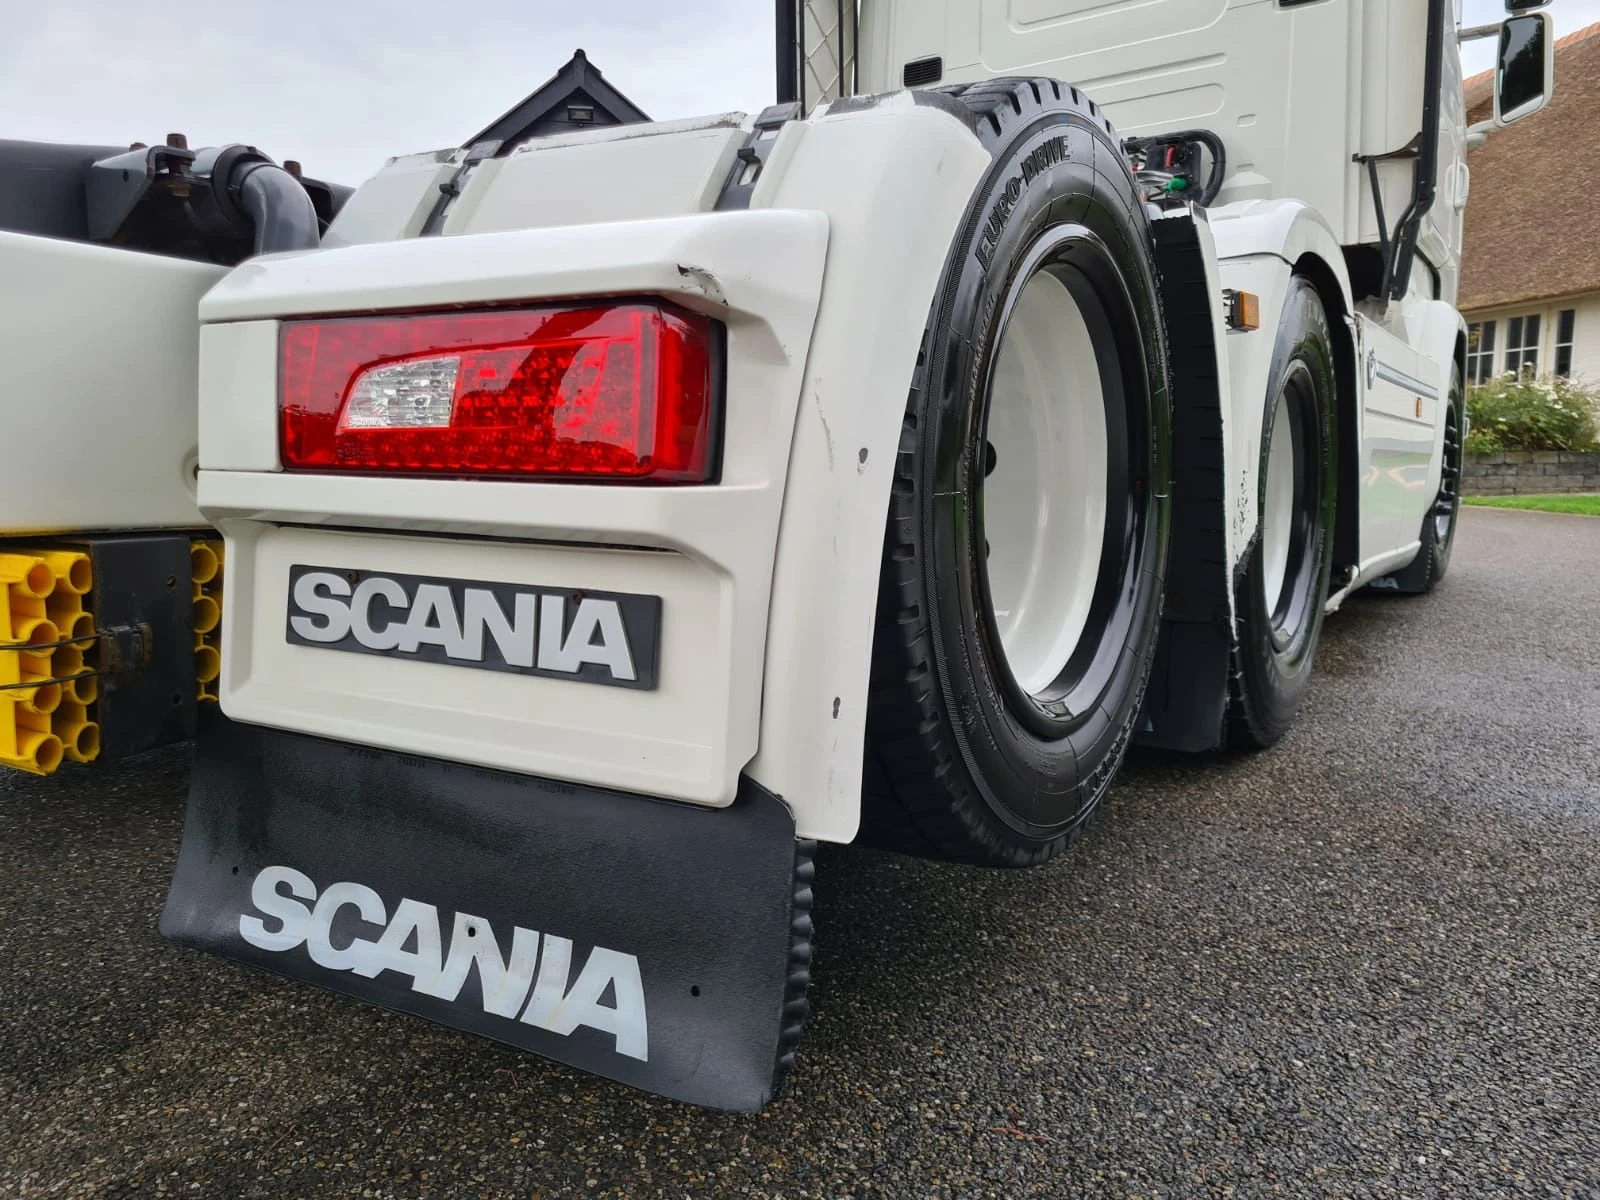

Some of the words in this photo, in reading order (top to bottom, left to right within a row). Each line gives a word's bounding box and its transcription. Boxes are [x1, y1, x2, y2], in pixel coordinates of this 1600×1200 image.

[975, 135, 1071, 272] EURO-DRIVE
[290, 572, 638, 682] SCANIA
[238, 864, 649, 1062] SCANIA
